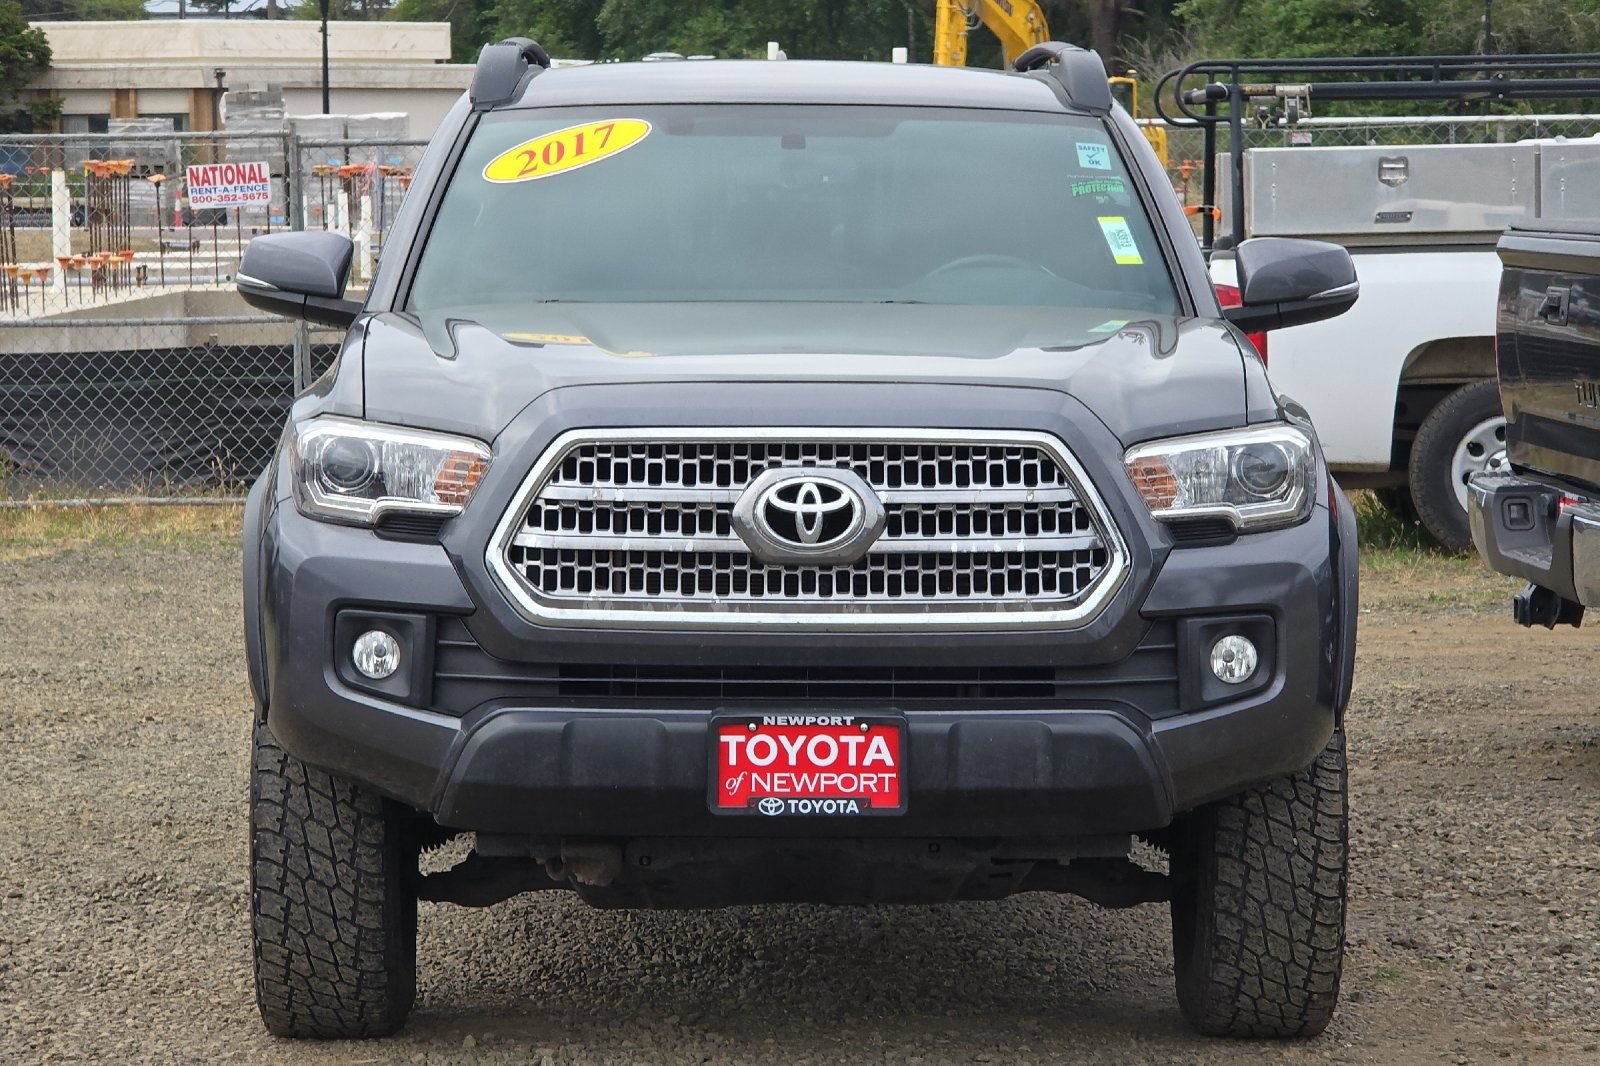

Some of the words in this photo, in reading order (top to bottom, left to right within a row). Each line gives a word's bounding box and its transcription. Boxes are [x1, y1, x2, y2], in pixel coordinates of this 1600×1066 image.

[515, 123, 616, 177] 2017
[188, 163, 268, 187] NATIONAL
[190, 184, 269, 195] RENT-A-FENCE
[191, 192, 269, 204] 800-352-5675
[763, 716, 855, 726] NEWPORT
[720, 734, 895, 767] TOYOTA
[725, 771, 748, 796] of
[751, 772, 897, 793] NEWPORT
[788, 799, 860, 814] TOYOTA
